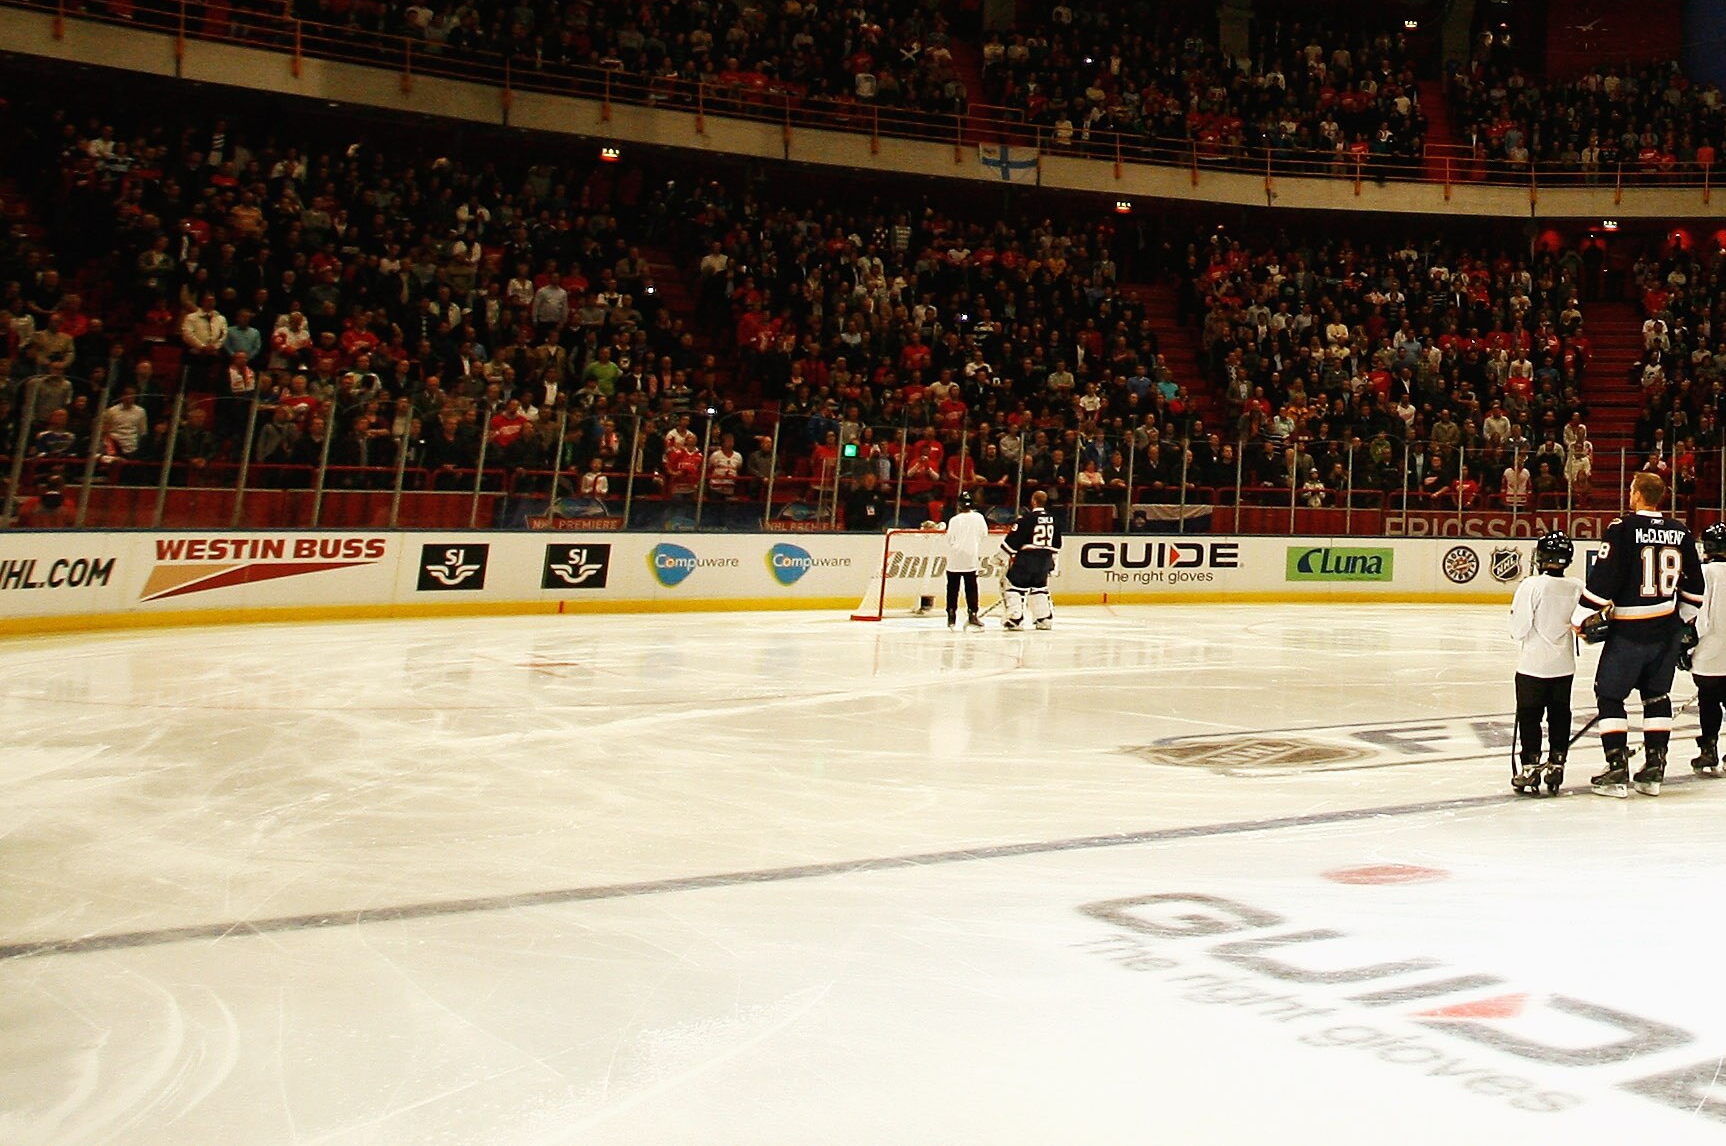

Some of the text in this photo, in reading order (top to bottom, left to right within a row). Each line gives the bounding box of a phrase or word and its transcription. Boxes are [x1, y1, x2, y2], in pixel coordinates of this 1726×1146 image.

[1033, 525, 1054, 547] 29
[155, 538, 387, 561] WESTIN BUSS
[445, 548, 466, 567] SJ
[567, 547, 588, 566] SJ
[1080, 542, 1239, 568] GUIDE
[655, 554, 739, 572] Compuware
[772, 553, 851, 571] Compuware
[1321, 547, 1383, 575] Luna
[1640, 545, 1682, 597] 18
[1104, 570, 1214, 585] The right gloves
[1296, 1024, 1588, 1114] gloves
